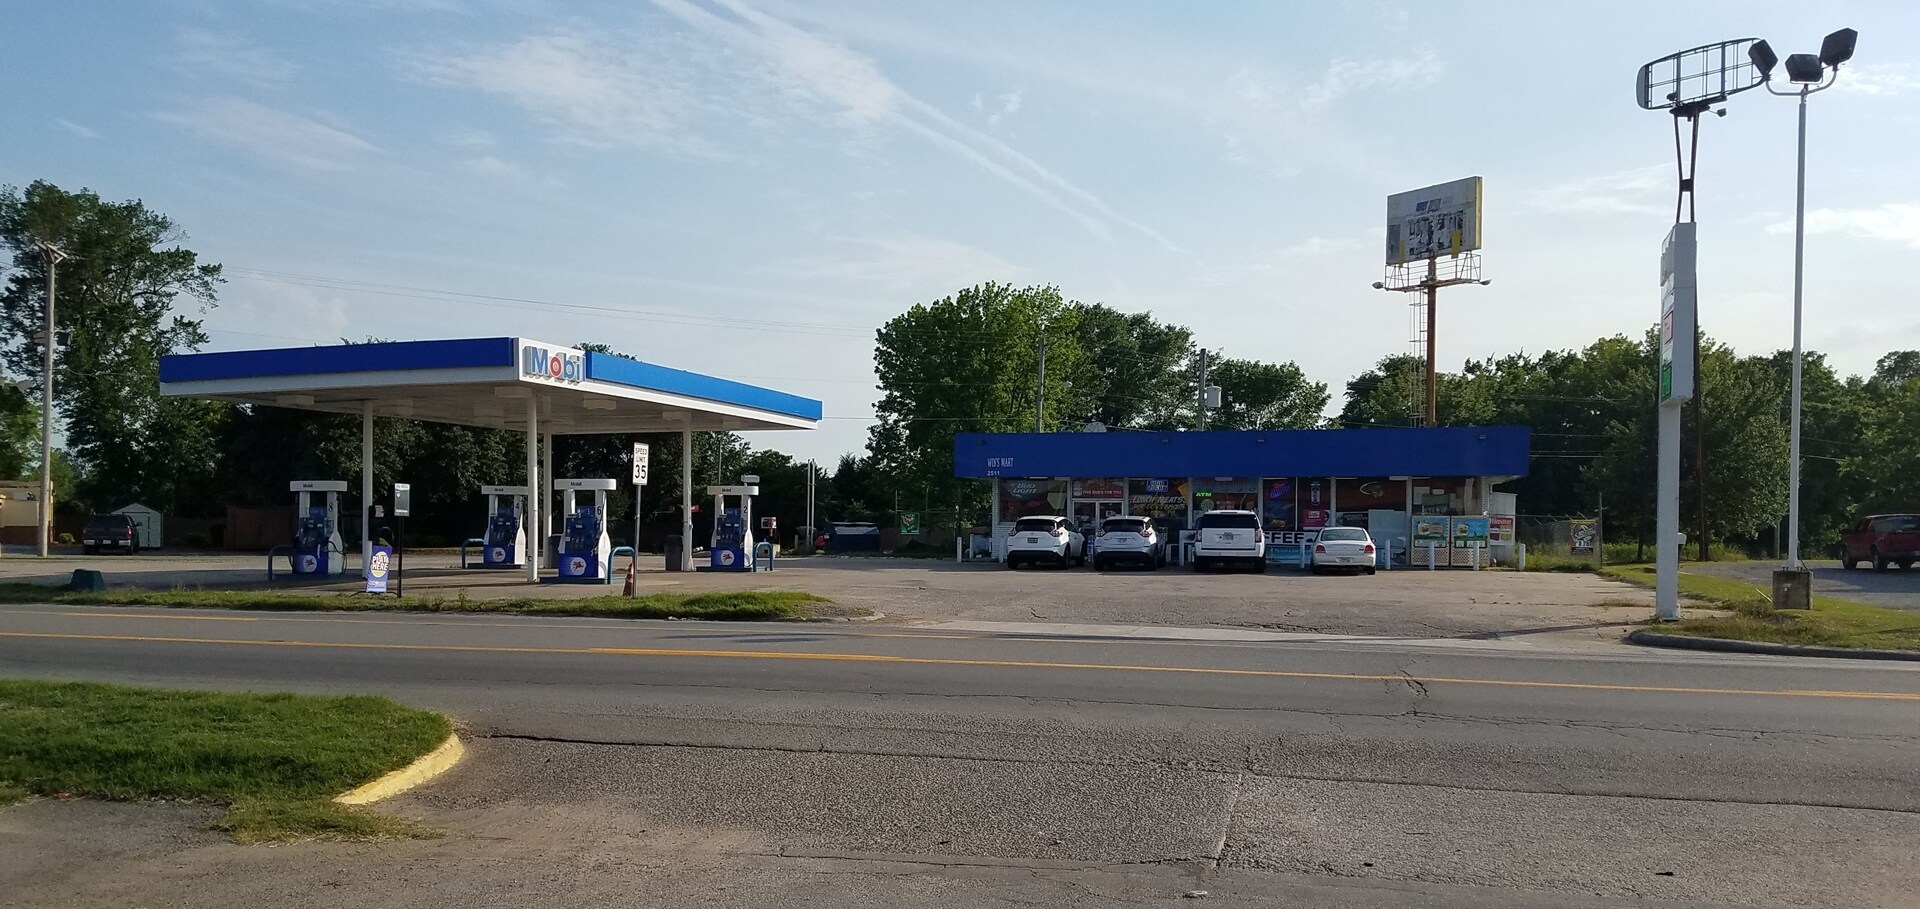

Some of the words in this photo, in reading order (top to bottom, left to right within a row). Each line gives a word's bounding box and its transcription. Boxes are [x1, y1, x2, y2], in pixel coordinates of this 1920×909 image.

[529, 346, 586, 384] Mobil
[636, 447, 648, 455] SPEED
[635, 464, 647, 479] 35
[328, 502, 334, 512] 8
[597, 505, 602, 516] 6
[744, 506, 748, 514] 2
